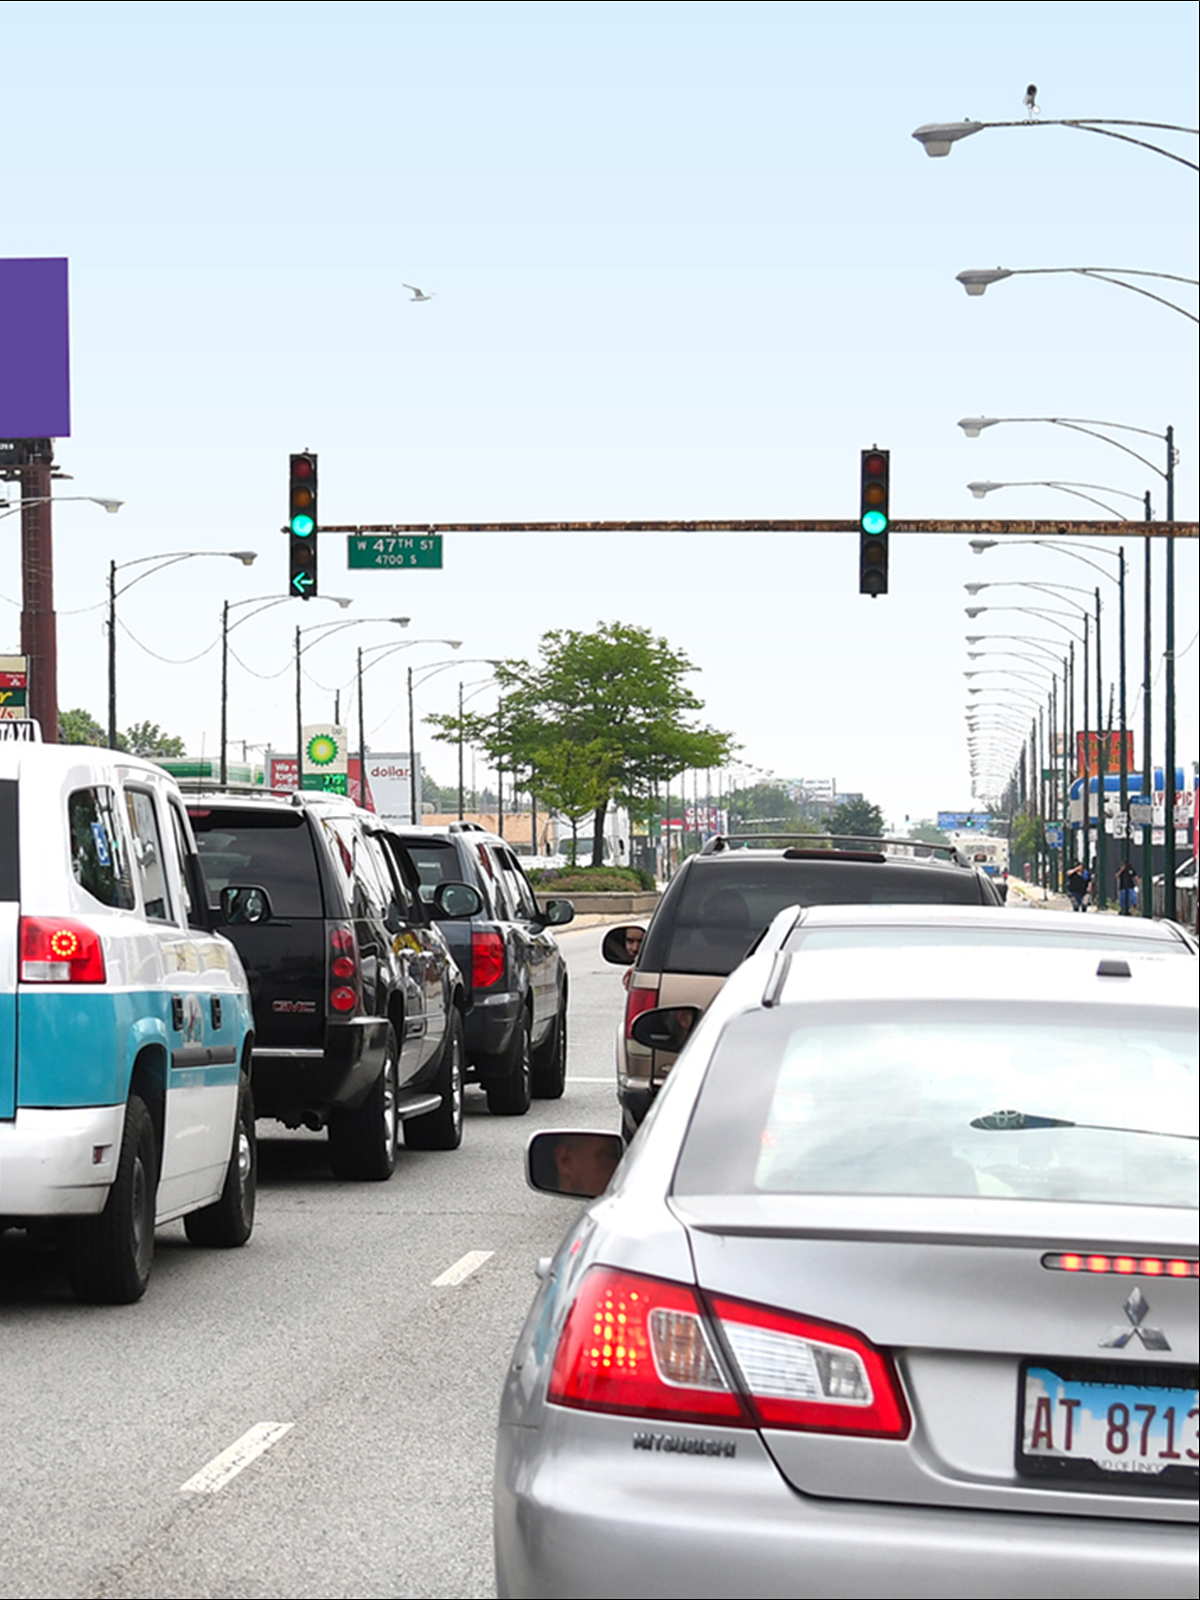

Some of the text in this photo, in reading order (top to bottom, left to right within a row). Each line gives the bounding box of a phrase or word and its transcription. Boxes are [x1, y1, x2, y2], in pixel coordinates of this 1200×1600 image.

[357, 538, 434, 553] W 47TH ST
[375, 554, 417, 565] 4700 S
[273, 1001, 316, 1012] GMC
[1031, 1397, 1081, 1451] AT
[633, 1432, 736, 1458] MITSUBISHI
